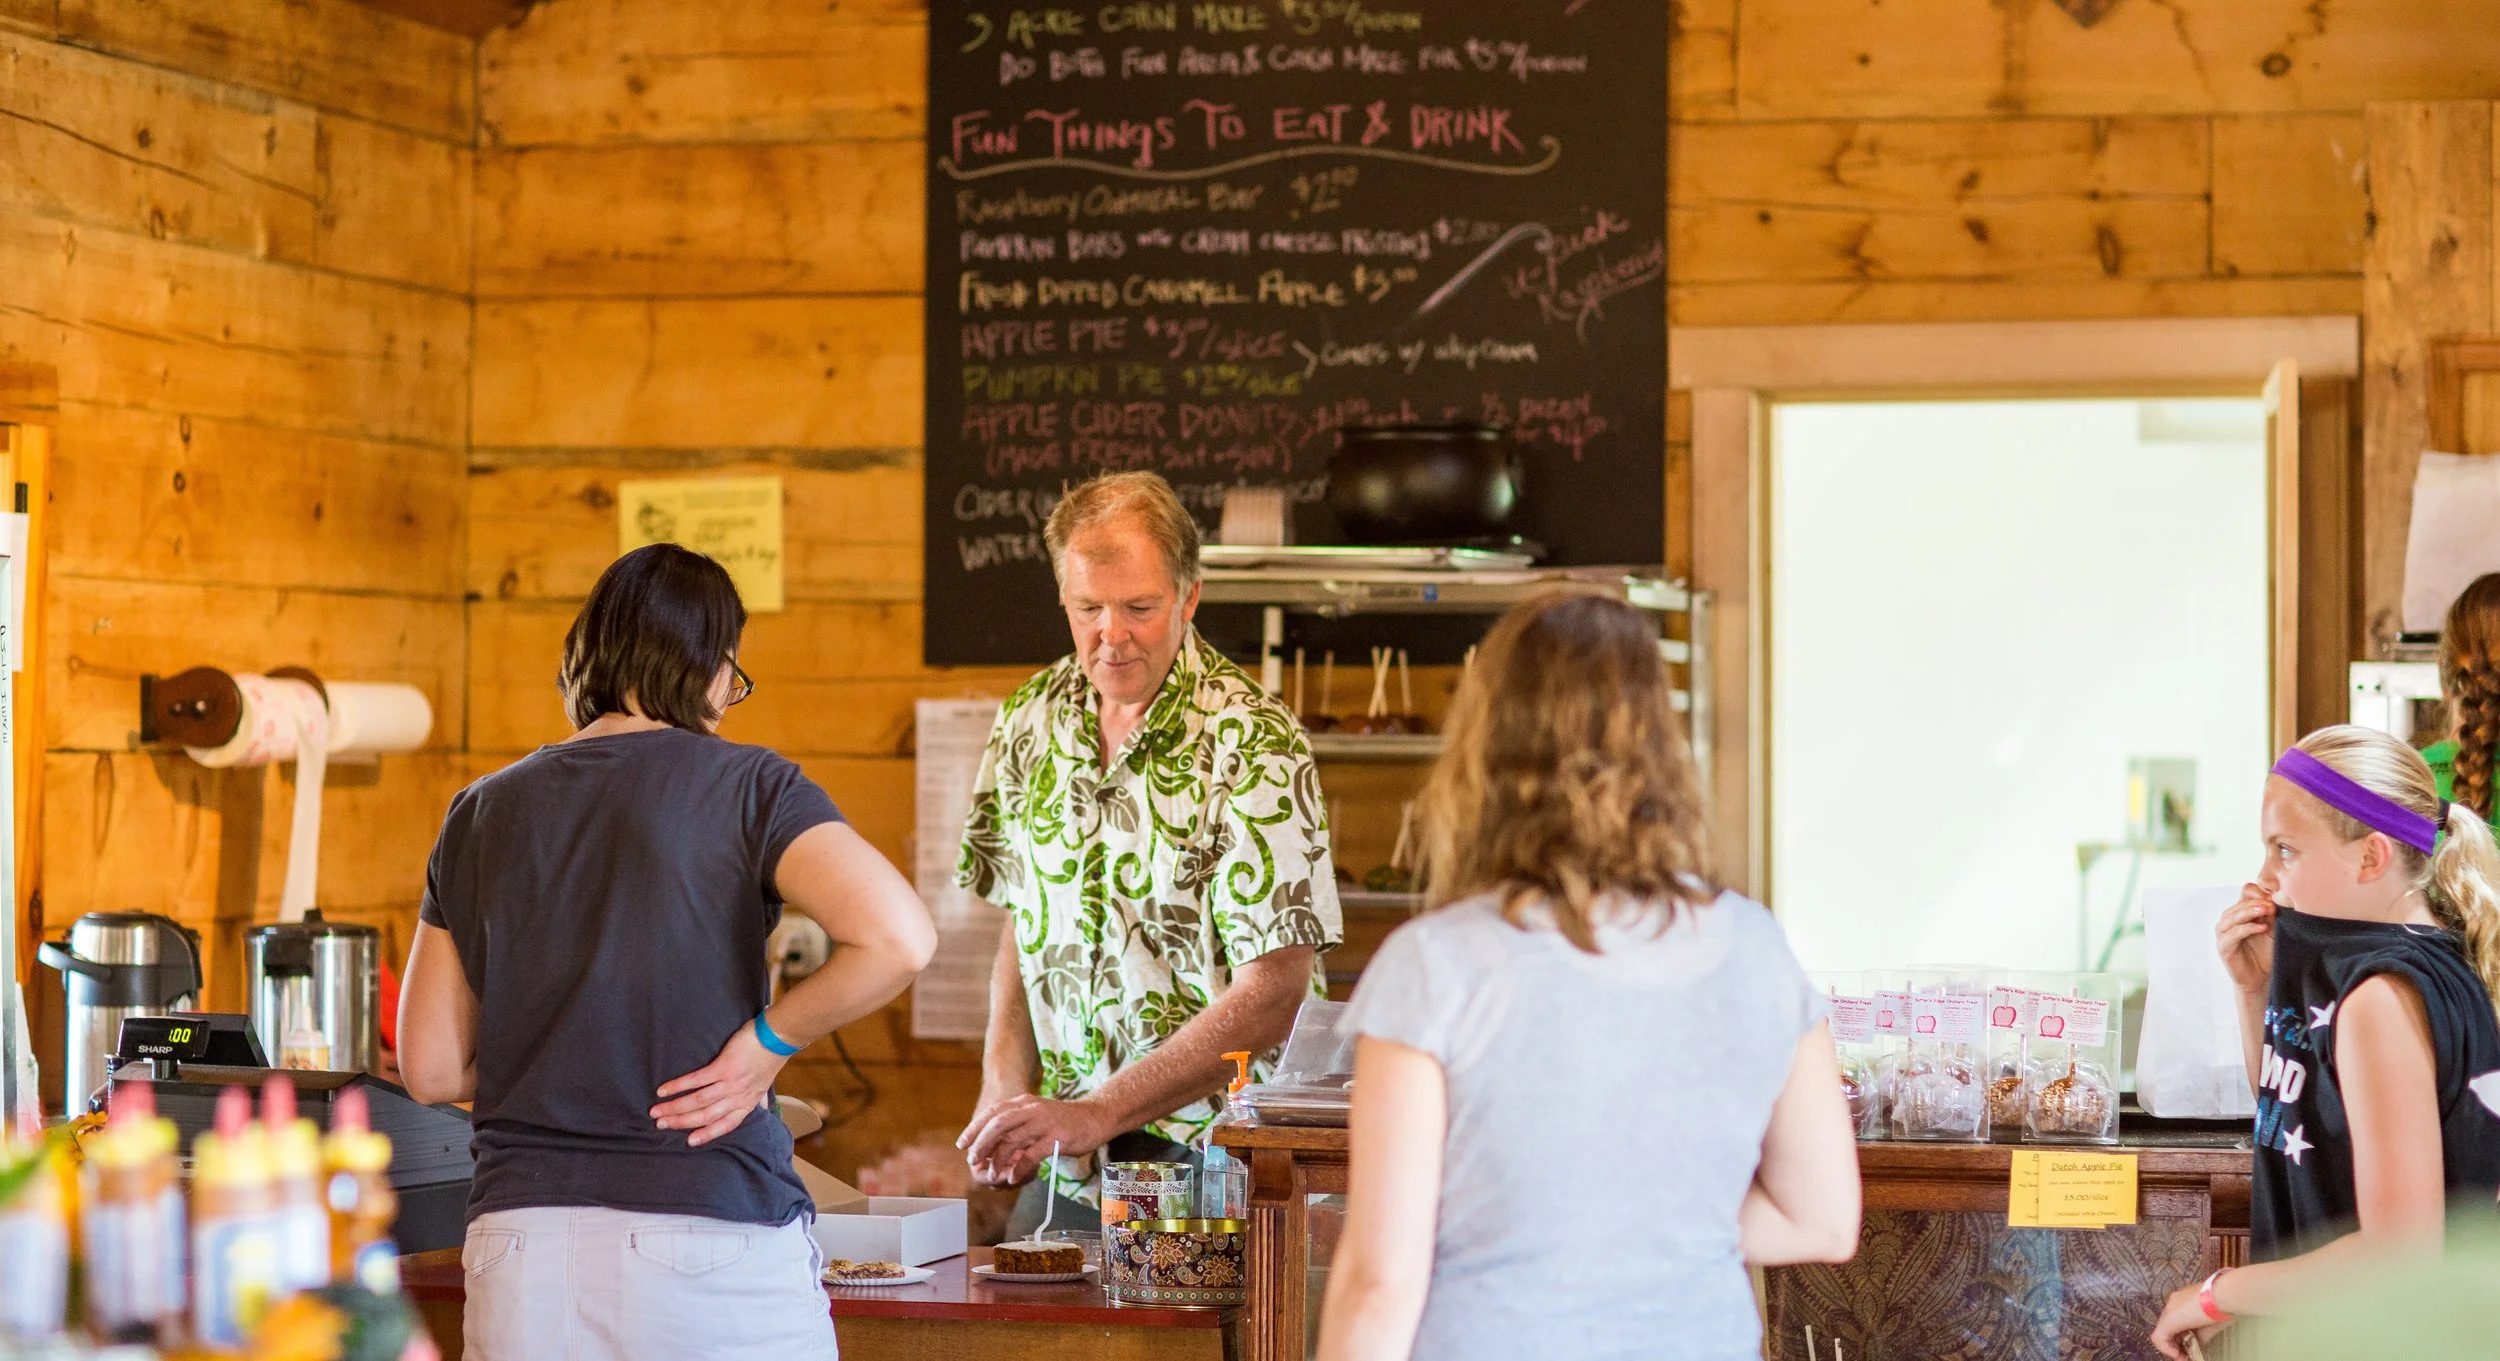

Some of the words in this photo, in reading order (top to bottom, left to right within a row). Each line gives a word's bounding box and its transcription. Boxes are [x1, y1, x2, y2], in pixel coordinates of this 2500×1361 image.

[1361, 99, 1391, 147] &
[1410, 103, 1527, 157] DRINK
[961, 319, 1058, 361] APPLE
[1067, 316, 1129, 352] PIE
[961, 363, 1100, 400] PUMPKIN
[961, 401, 1061, 442] APPLE
[1070, 399, 1168, 440] CIDER
[138, 1045, 173, 1054] SHARP
[2051, 1162, 2078, 1171] Dutch
[2081, 1162, 2106, 1172] Apple
[2109, 1161, 2123, 1170] Pie
